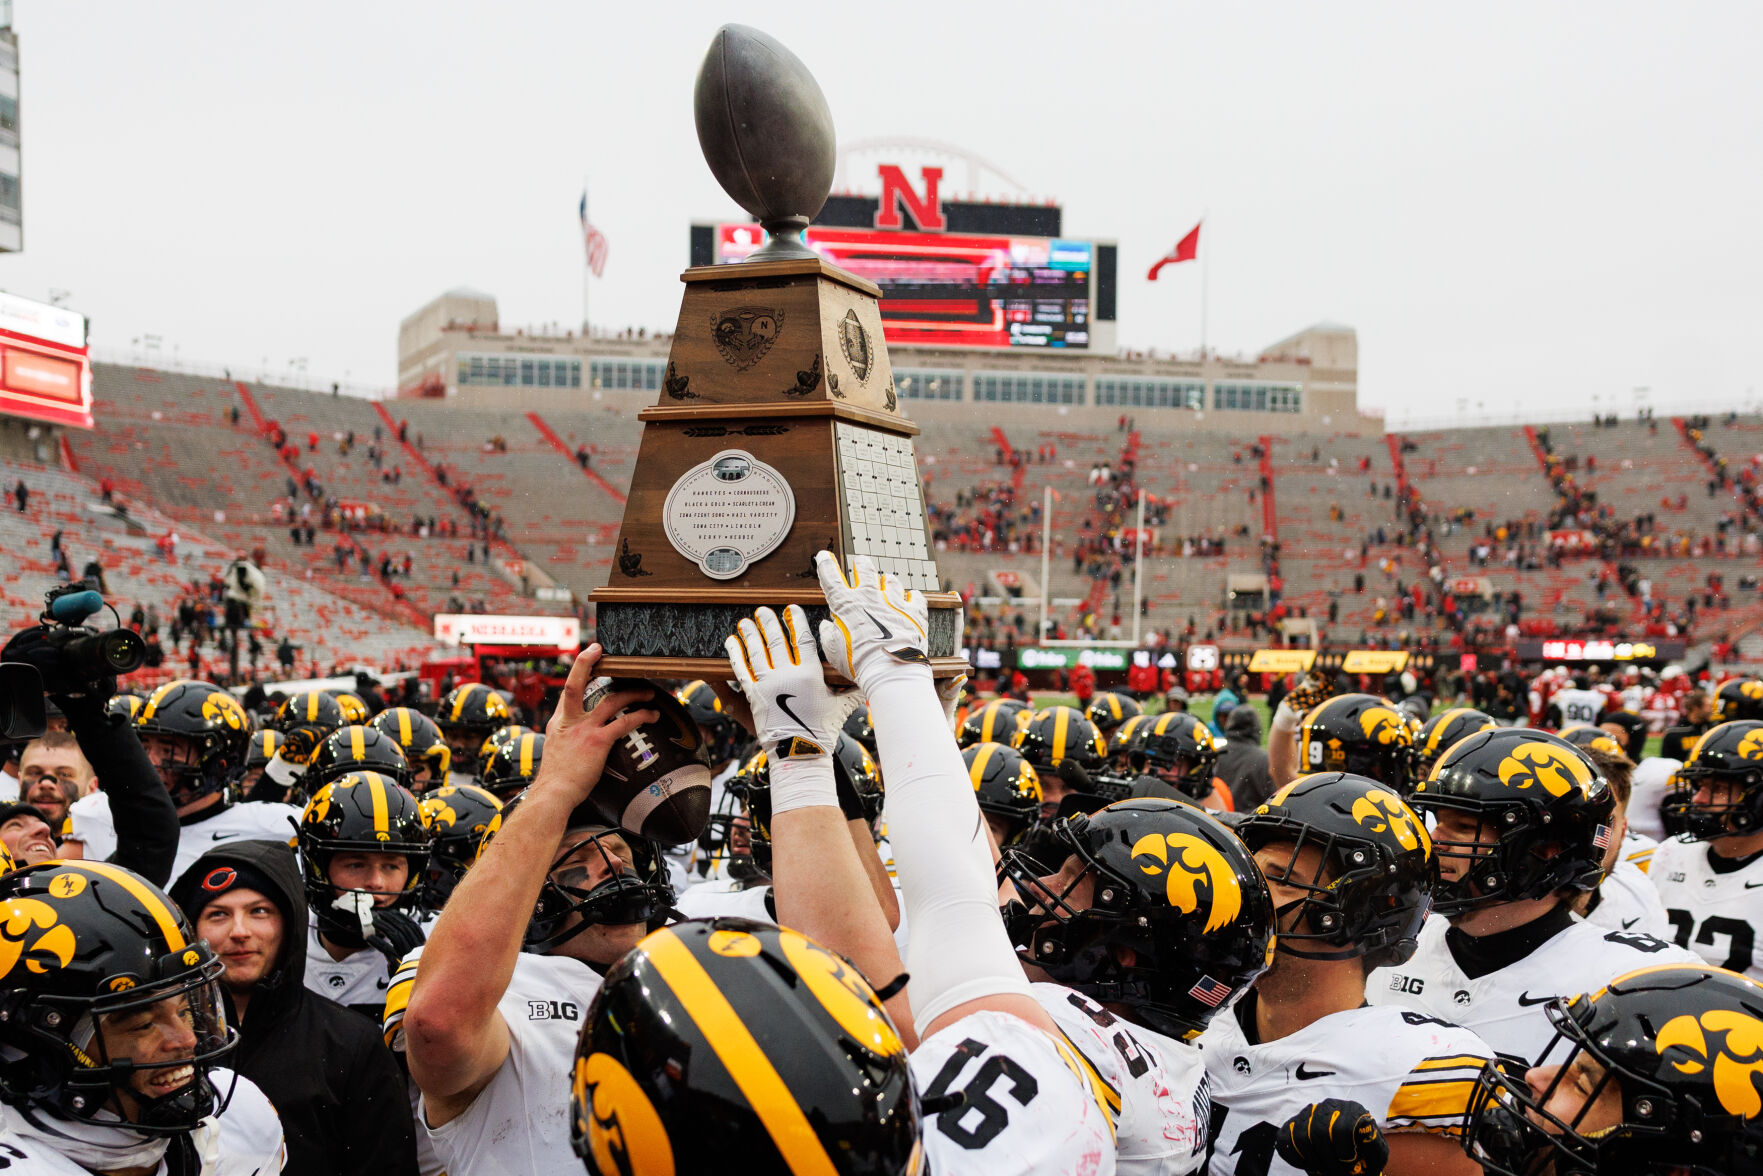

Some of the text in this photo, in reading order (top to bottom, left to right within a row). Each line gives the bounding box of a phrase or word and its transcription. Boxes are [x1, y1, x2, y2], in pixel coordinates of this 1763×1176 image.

[874, 164, 947, 231] N
[760, 321, 768, 330] N
[1567, 704, 1593, 722] 90
